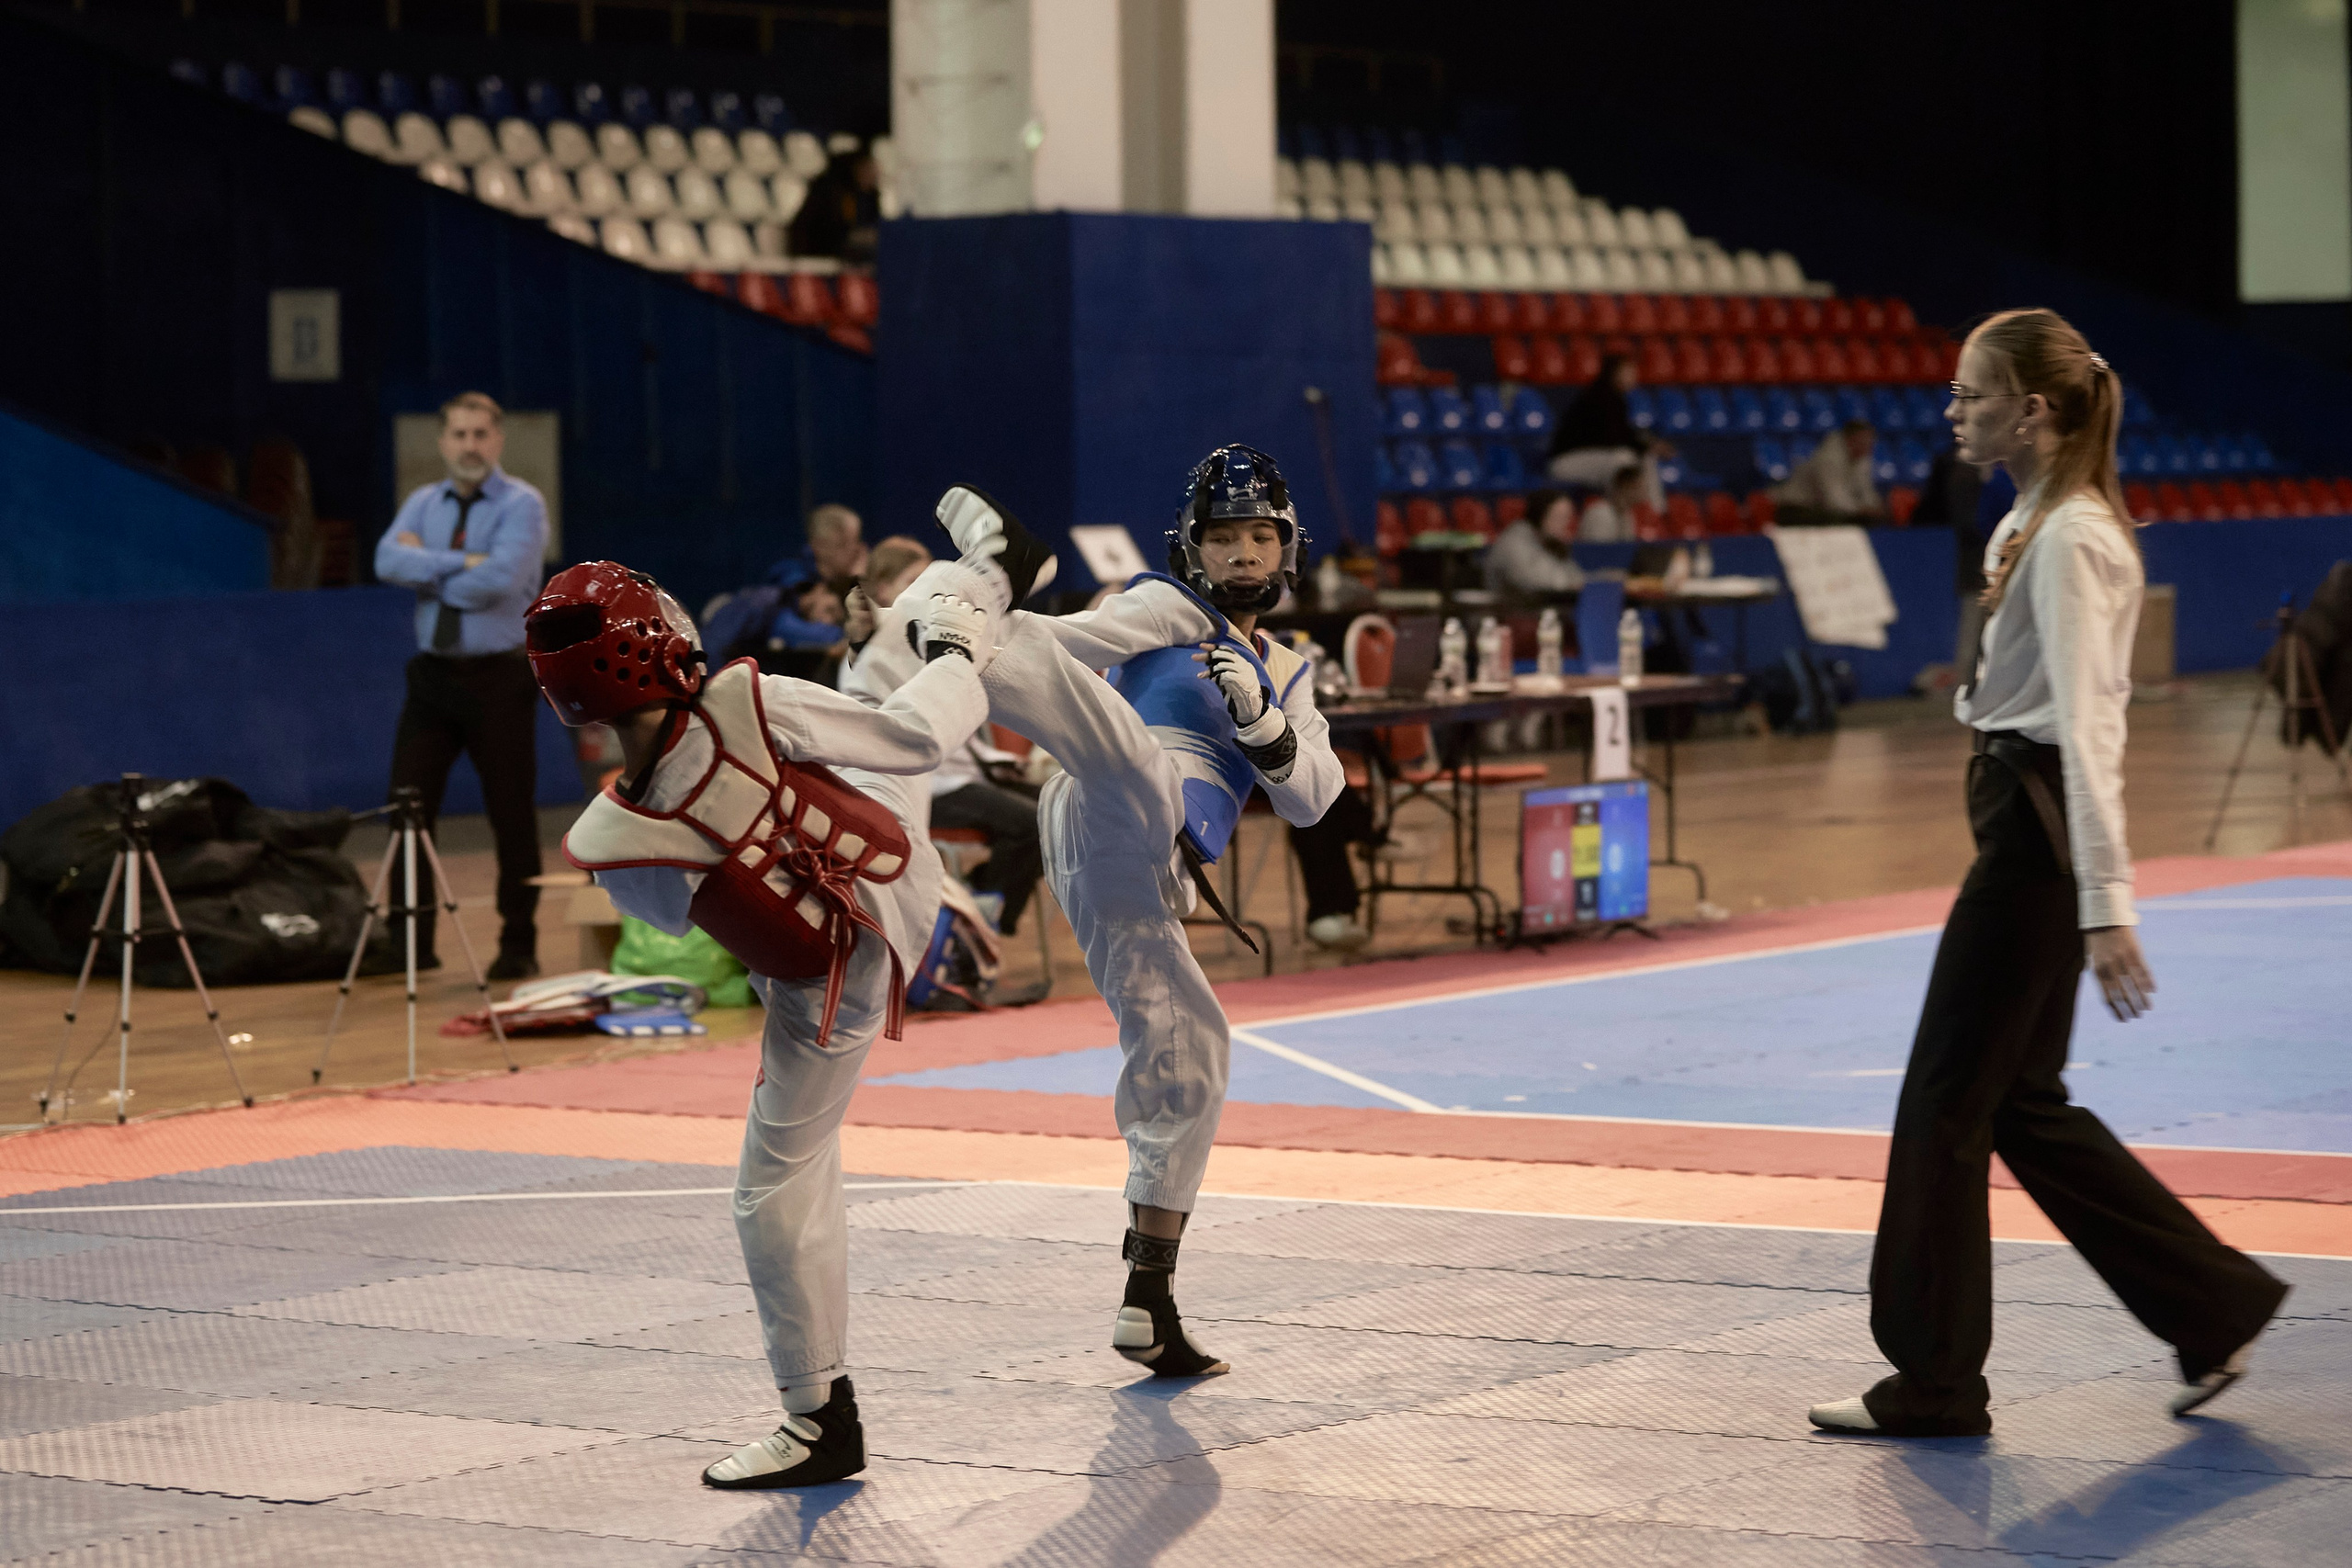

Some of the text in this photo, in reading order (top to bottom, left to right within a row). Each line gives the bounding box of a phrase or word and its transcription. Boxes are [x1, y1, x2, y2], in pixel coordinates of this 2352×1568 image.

[939, 632, 971, 646] KHAN
[1606, 704, 1620, 747] 2
[1200, 820, 1209, 837] 1
